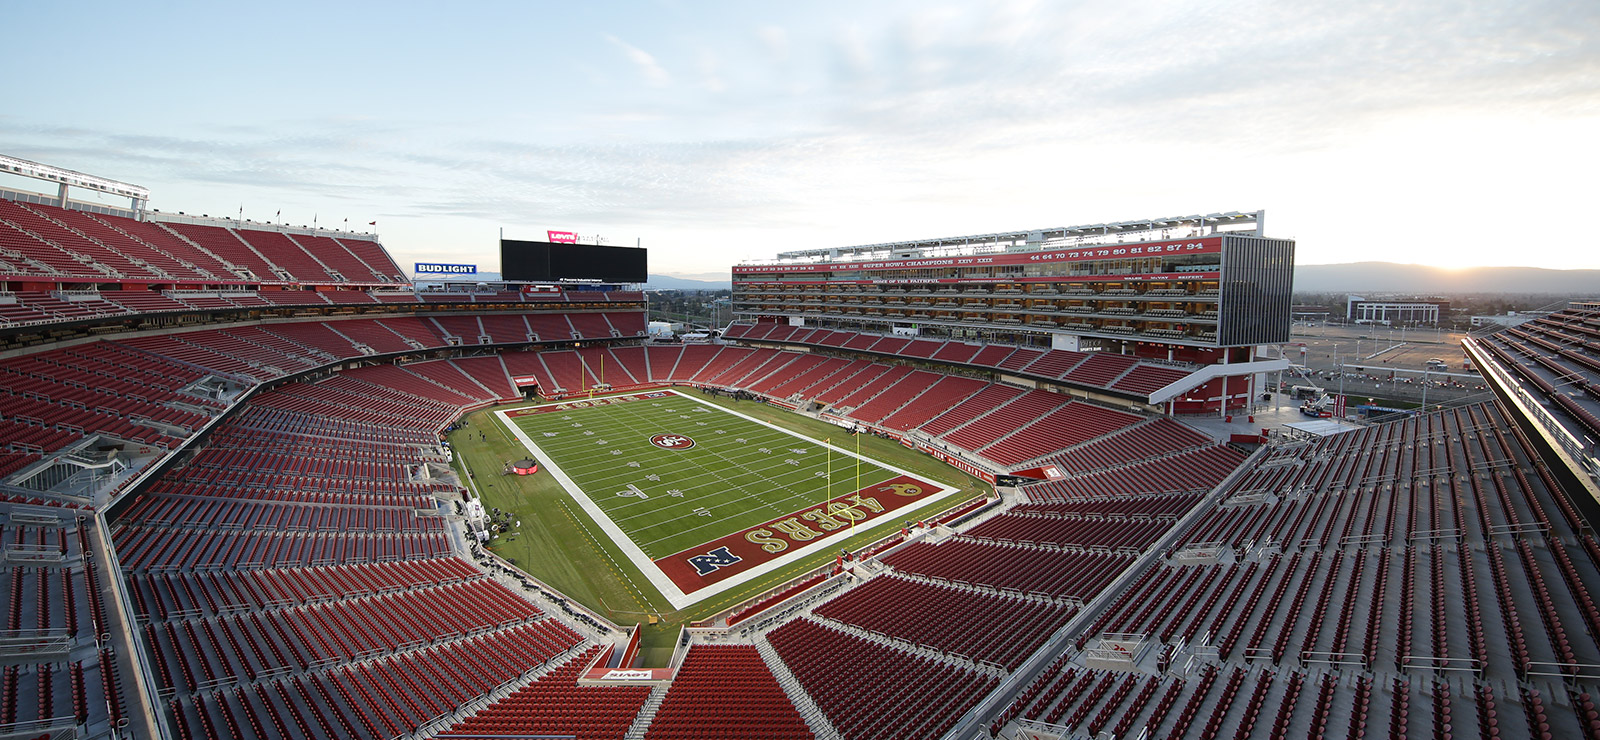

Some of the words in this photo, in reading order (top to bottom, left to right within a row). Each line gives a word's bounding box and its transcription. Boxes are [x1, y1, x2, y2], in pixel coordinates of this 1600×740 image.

[1186, 242, 1204, 250] 94
[906, 259, 954, 267] CHAMPIONS
[744, 494, 885, 554] 49ERS
